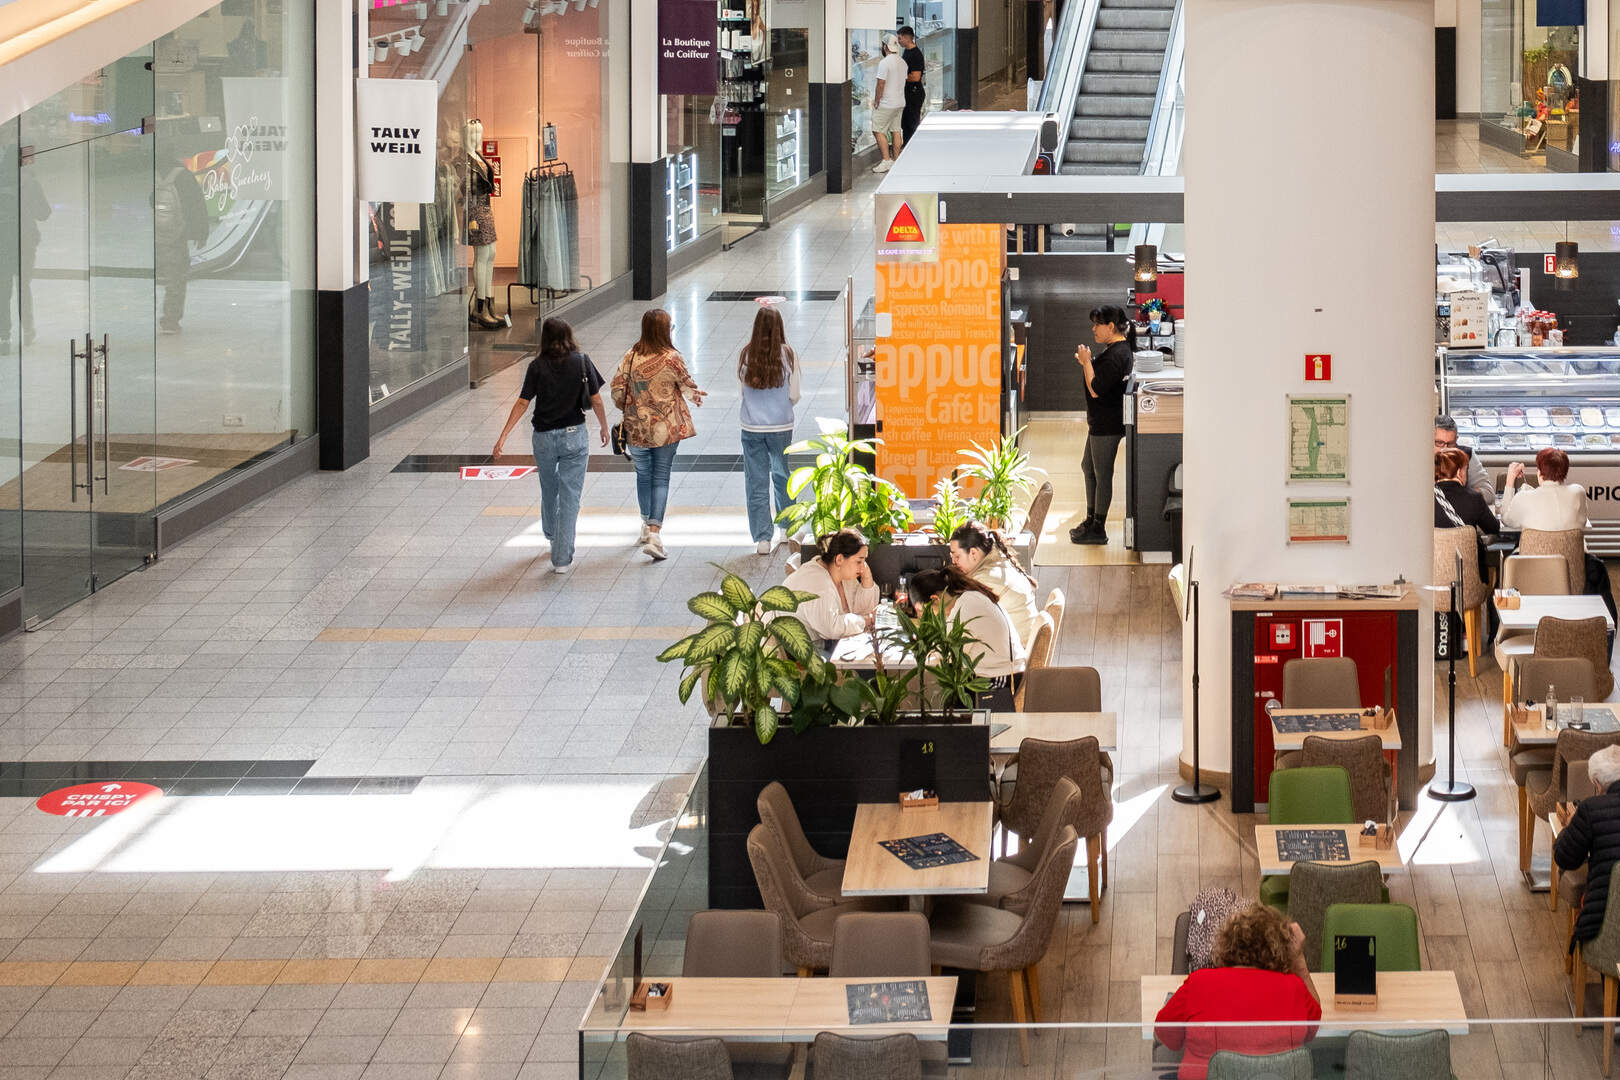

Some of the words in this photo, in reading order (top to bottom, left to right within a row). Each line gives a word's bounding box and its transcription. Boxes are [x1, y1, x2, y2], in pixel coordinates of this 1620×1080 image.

[663, 38, 672, 46] La
[674, 37, 711, 49] Boutique
[663, 49, 674, 58] du
[676, 49, 710, 59] Coiffeur
[371, 127, 421, 139] TALLY
[203, 169, 229, 211] Baby
[892, 226, 919, 234] DELTA
[951, 226, 986, 246] with
[888, 247, 989, 299] Doppio
[889, 300, 938, 320] Espresso
[940, 300, 985, 316] Romano
[926, 392, 974, 425] Café
[881, 448, 916, 465] Breve
